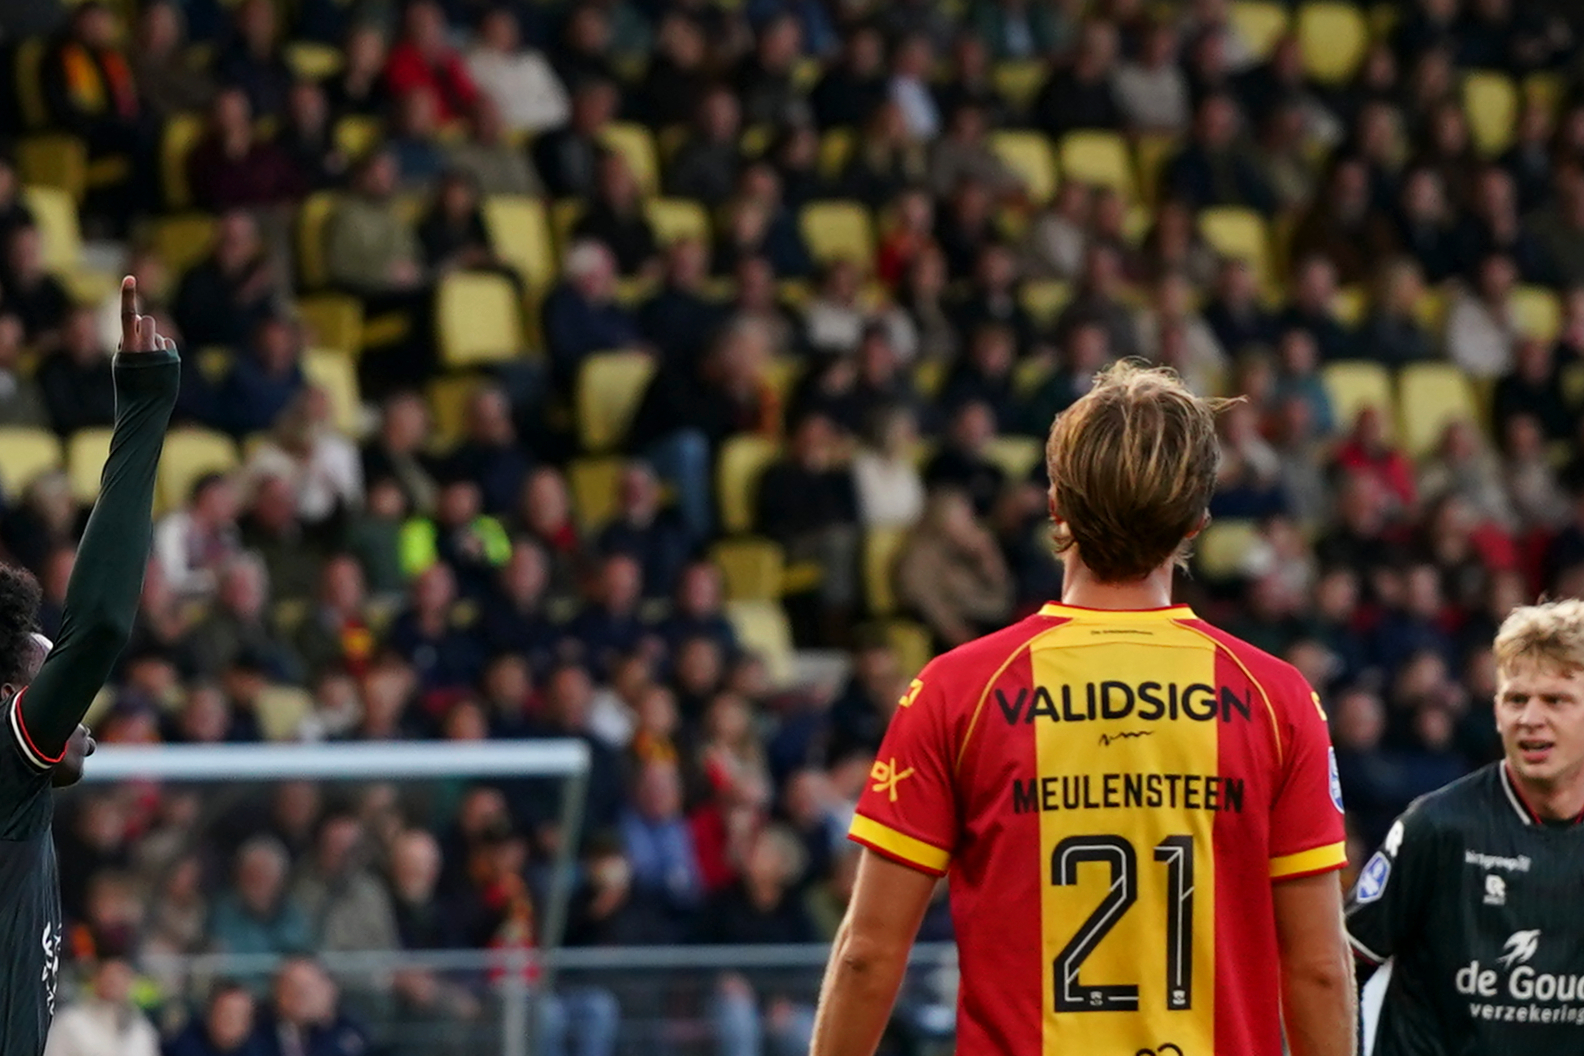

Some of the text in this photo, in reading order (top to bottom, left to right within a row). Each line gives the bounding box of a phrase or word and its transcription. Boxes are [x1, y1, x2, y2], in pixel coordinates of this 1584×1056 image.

[994, 680, 1251, 725] VALIDSIGN
[1012, 773, 1244, 814] MEULENSTEEN
[1051, 834, 1195, 1013] 21
[1455, 960, 1497, 997] de
